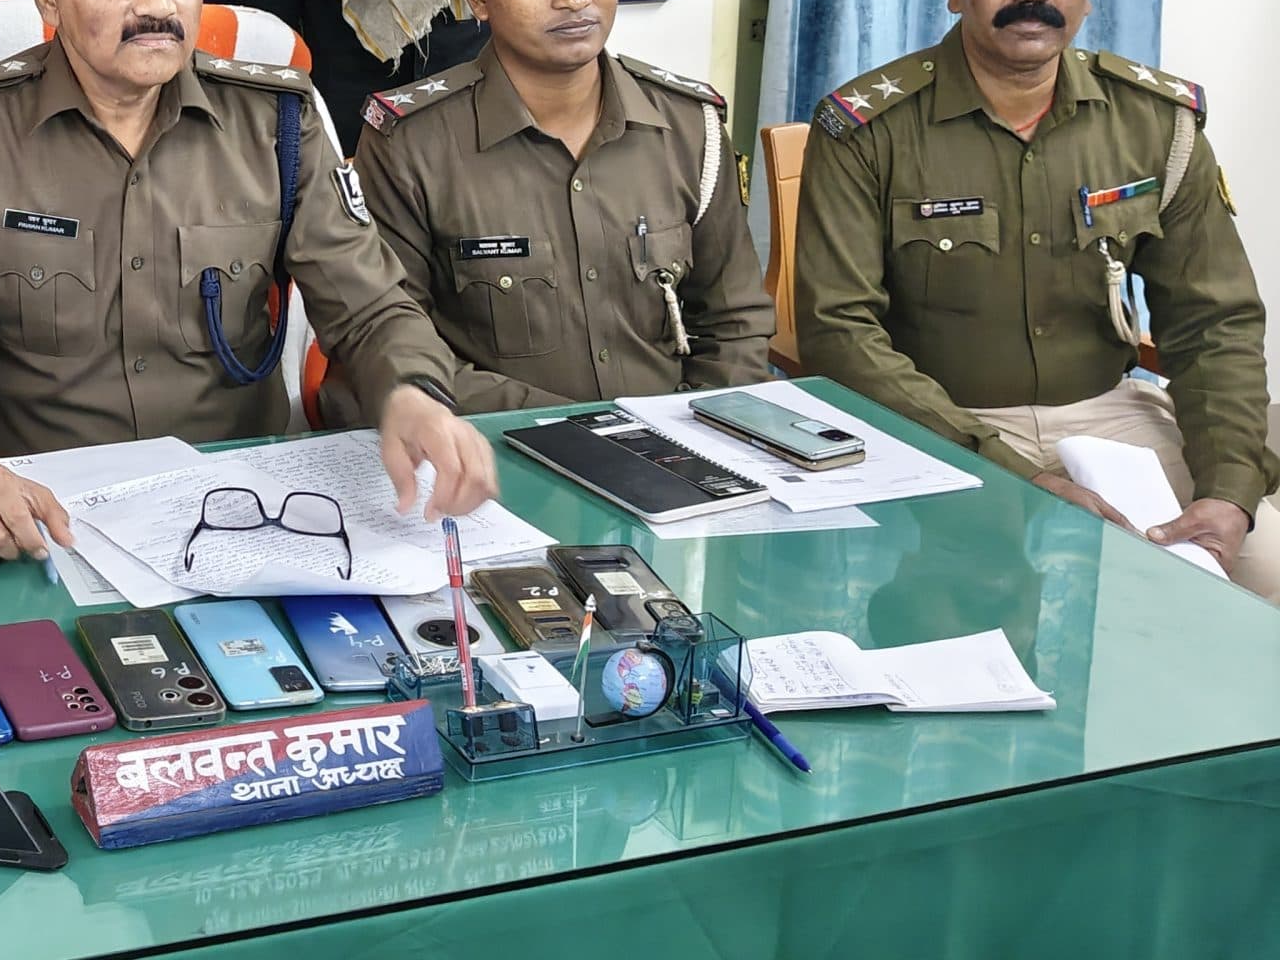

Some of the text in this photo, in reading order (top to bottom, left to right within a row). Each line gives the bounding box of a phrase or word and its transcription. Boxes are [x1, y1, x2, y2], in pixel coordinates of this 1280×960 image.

[114, 714, 409, 793] बलवन्त कुमार
[230, 757, 406, 802] थाना अध्यक्ष
